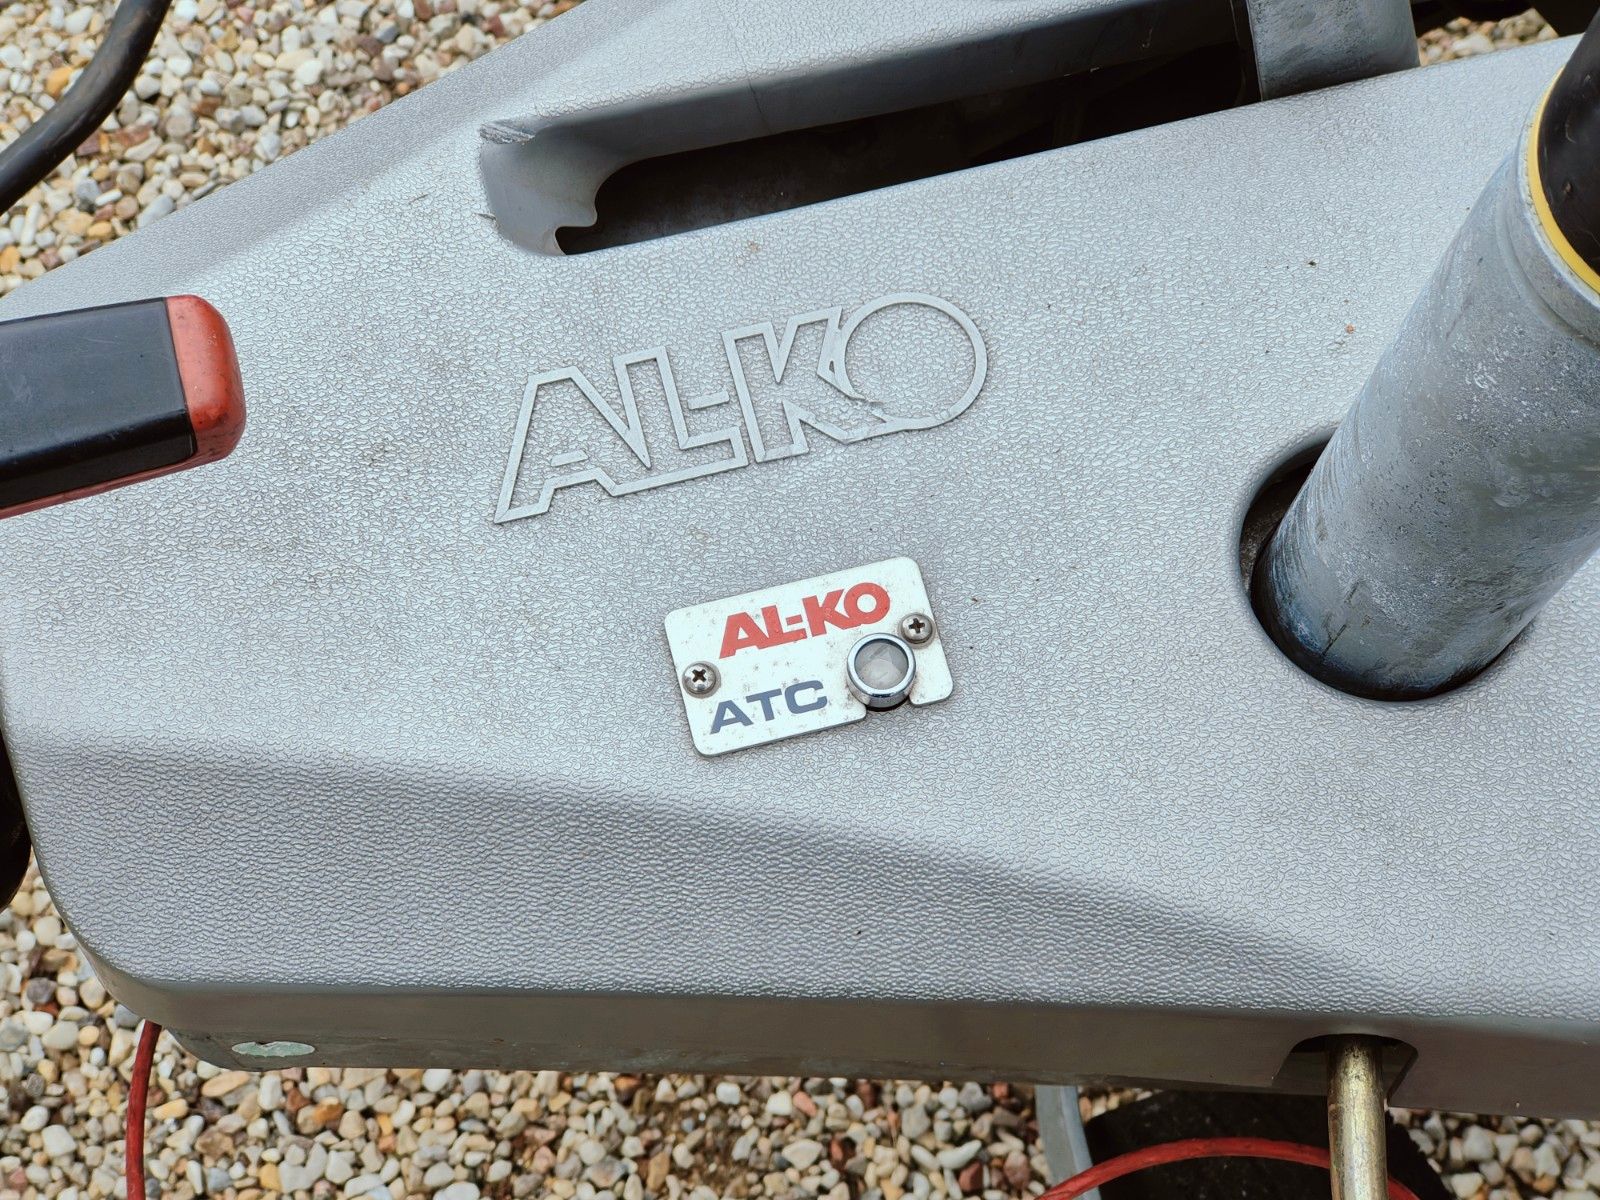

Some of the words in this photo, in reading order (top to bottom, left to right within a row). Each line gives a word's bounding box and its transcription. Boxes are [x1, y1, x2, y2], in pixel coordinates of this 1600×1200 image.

[494, 292, 988, 523] AL-KO
[719, 582, 891, 659] AL-KO
[710, 680, 828, 735] ATC
